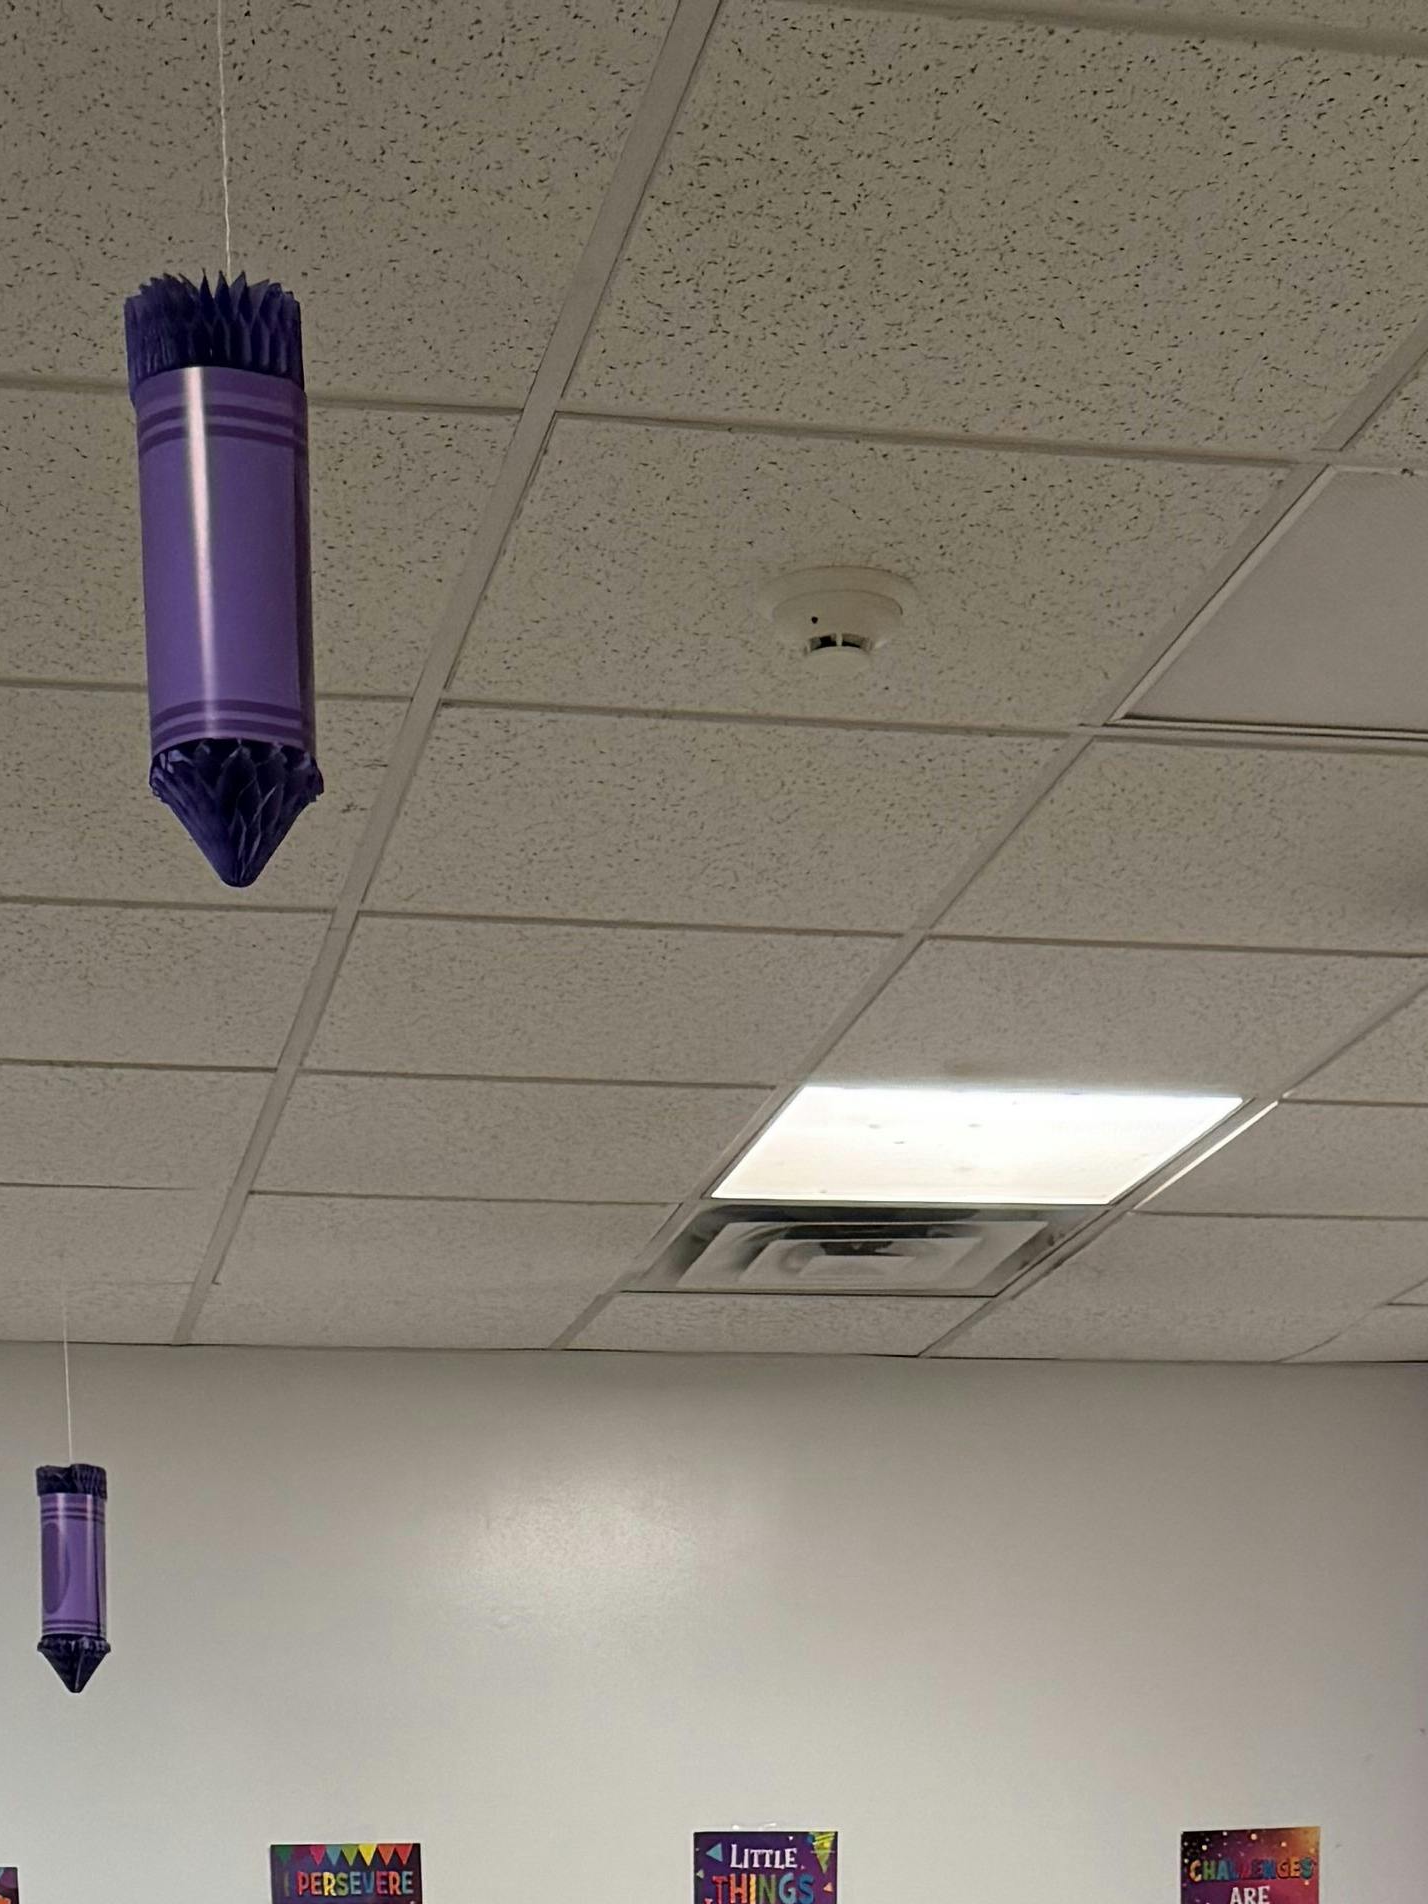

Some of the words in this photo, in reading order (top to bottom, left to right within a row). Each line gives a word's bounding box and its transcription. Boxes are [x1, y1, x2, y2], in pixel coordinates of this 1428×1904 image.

[730, 1844, 797, 1869] LITTLE
[297, 1871, 414, 1896] PERSEVERE
[712, 1873, 814, 1904] THINGS
